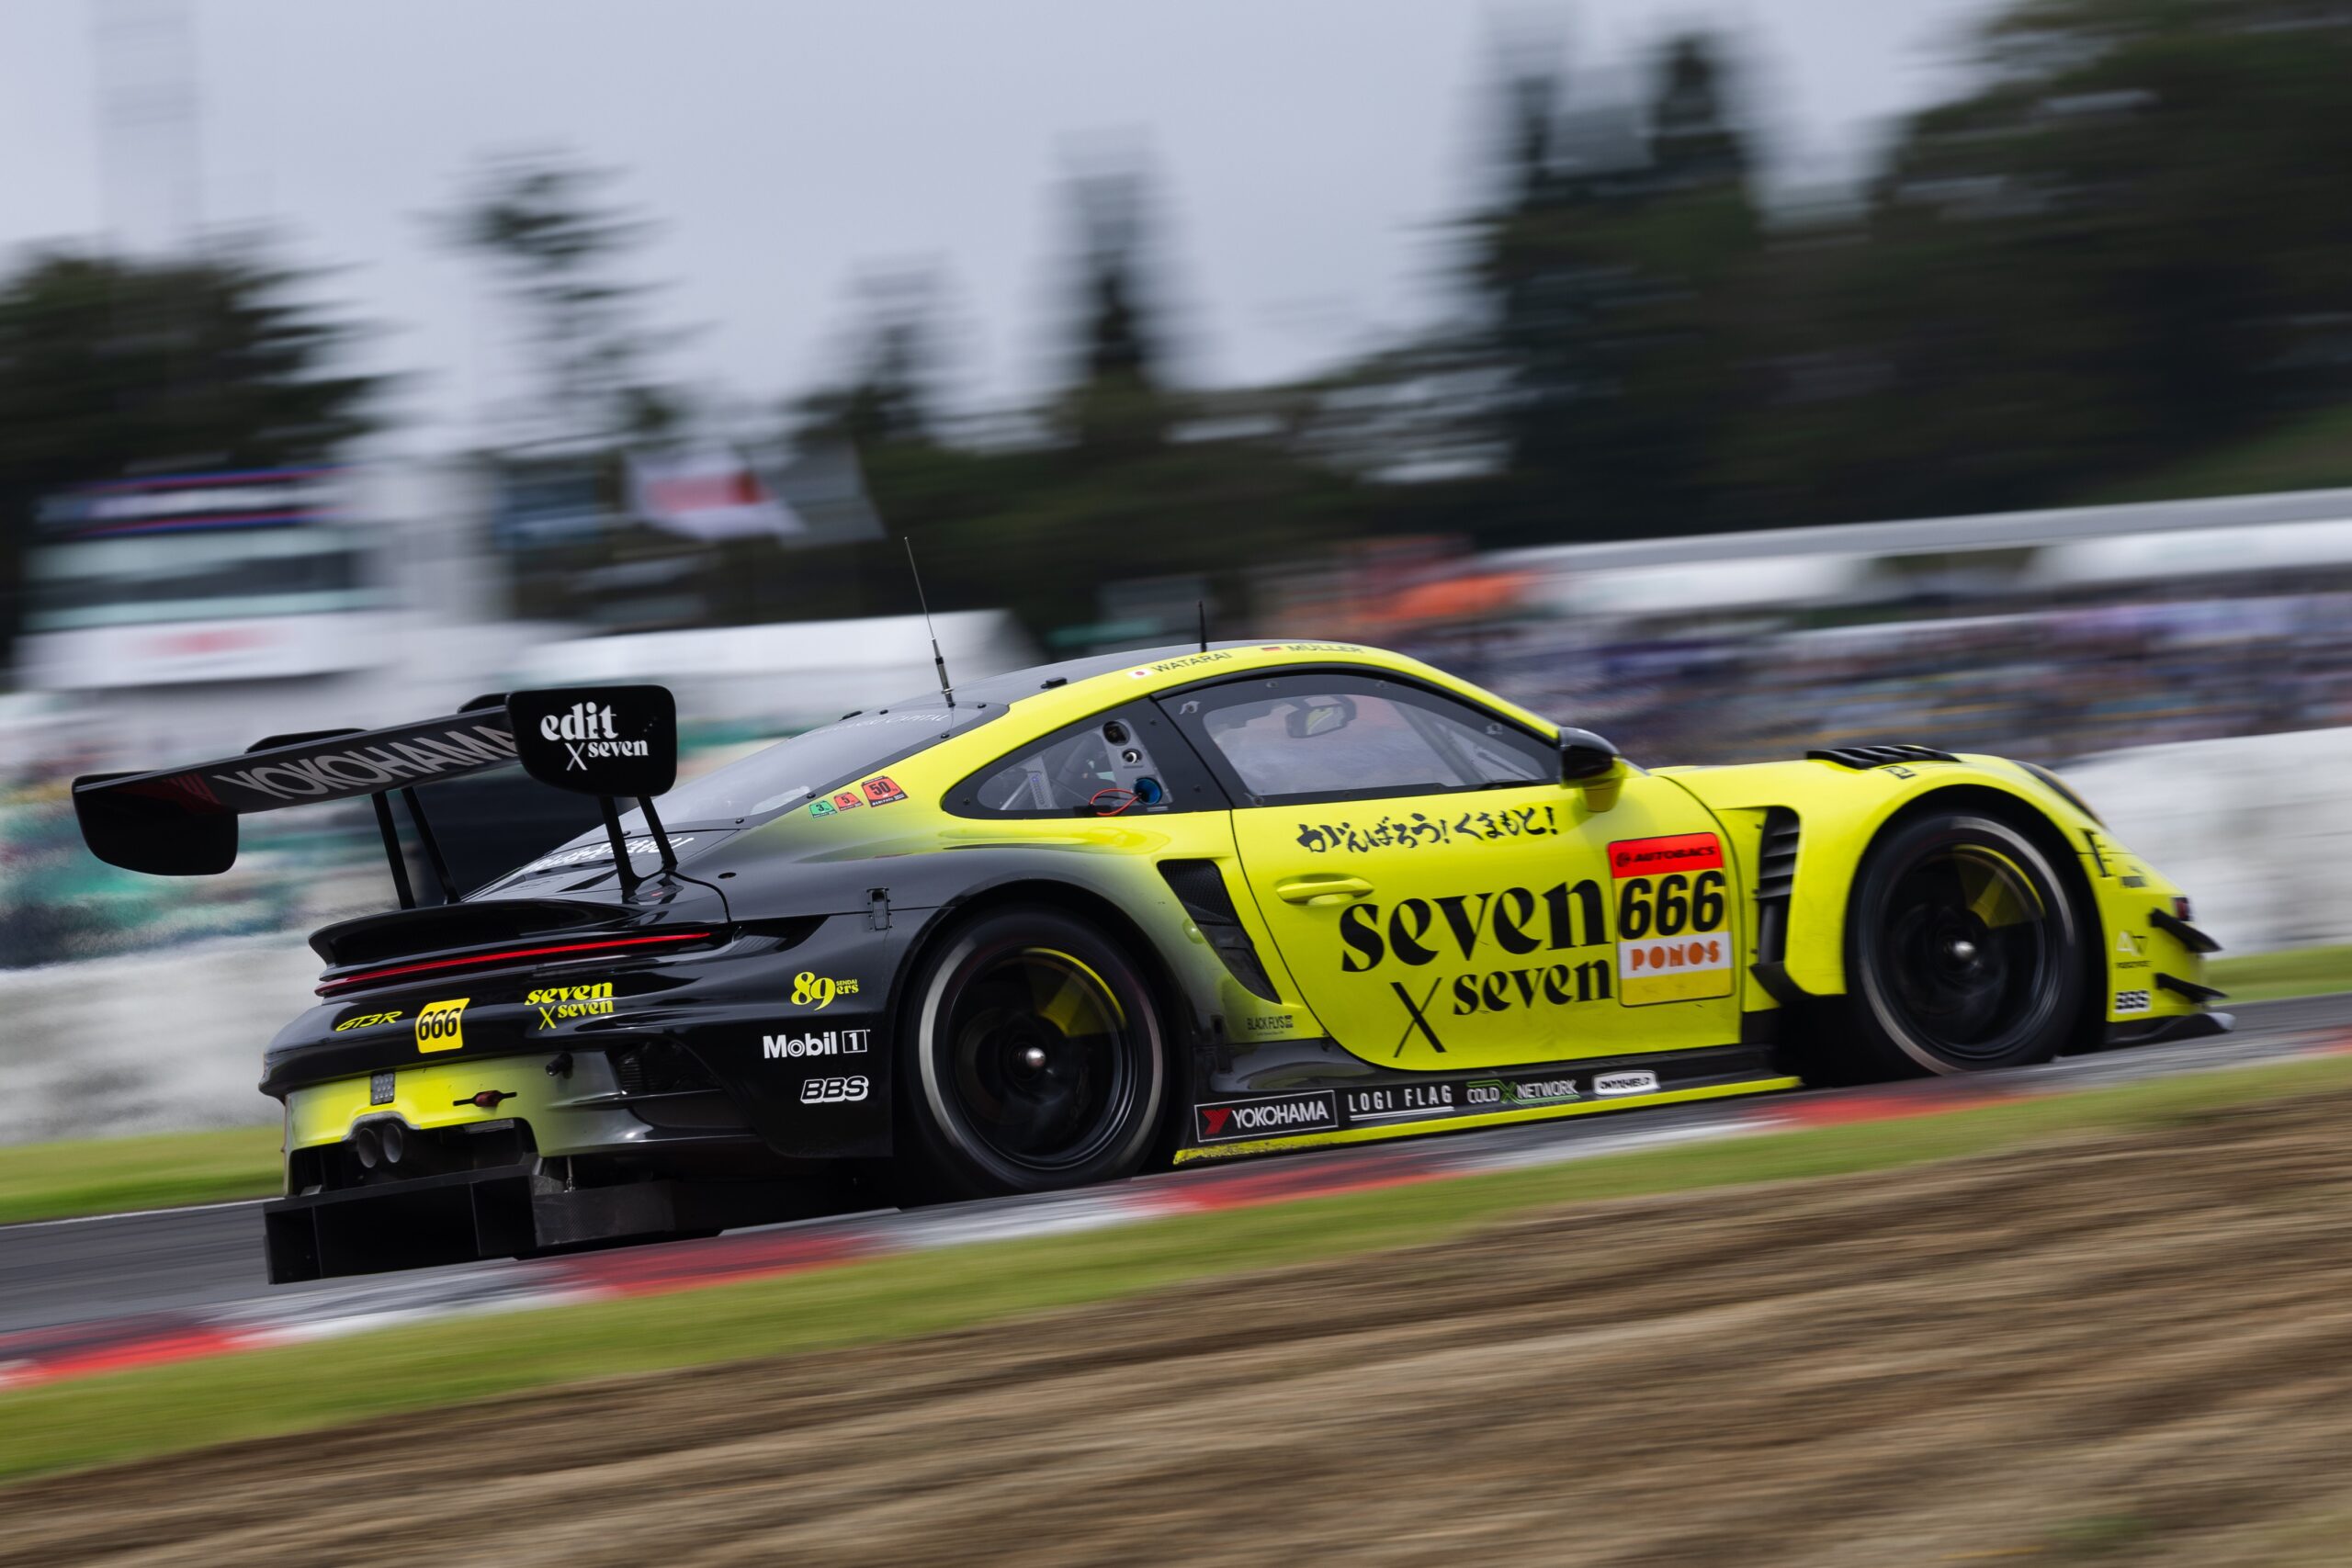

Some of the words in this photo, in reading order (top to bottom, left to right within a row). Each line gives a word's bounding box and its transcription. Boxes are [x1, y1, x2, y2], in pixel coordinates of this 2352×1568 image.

[1151, 652, 1232, 671] WATARAI
[540, 702, 618, 741] edit
[213, 726, 518, 799] YOKOHAMA
[587, 739, 649, 758] seven
[868, 781, 891, 795] 50
[1619, 871, 1725, 940] 666
[1340, 879, 1612, 973] seven
[1631, 940, 1720, 971] PONOS
[524, 982, 614, 1006] seven
[1453, 959, 1615, 1016] seven
[558, 1000, 614, 1018] seven
[418, 1007, 461, 1041] 666
[763, 1032, 838, 1059] Mobil
[800, 1076, 869, 1104] BBS
[1348, 1090, 1393, 1111] LOGI
[1404, 1085, 1453, 1109] FLAG
[1516, 1079, 1578, 1099] NETWORK
[1231, 1100, 1329, 1129] YOKOHAMA
